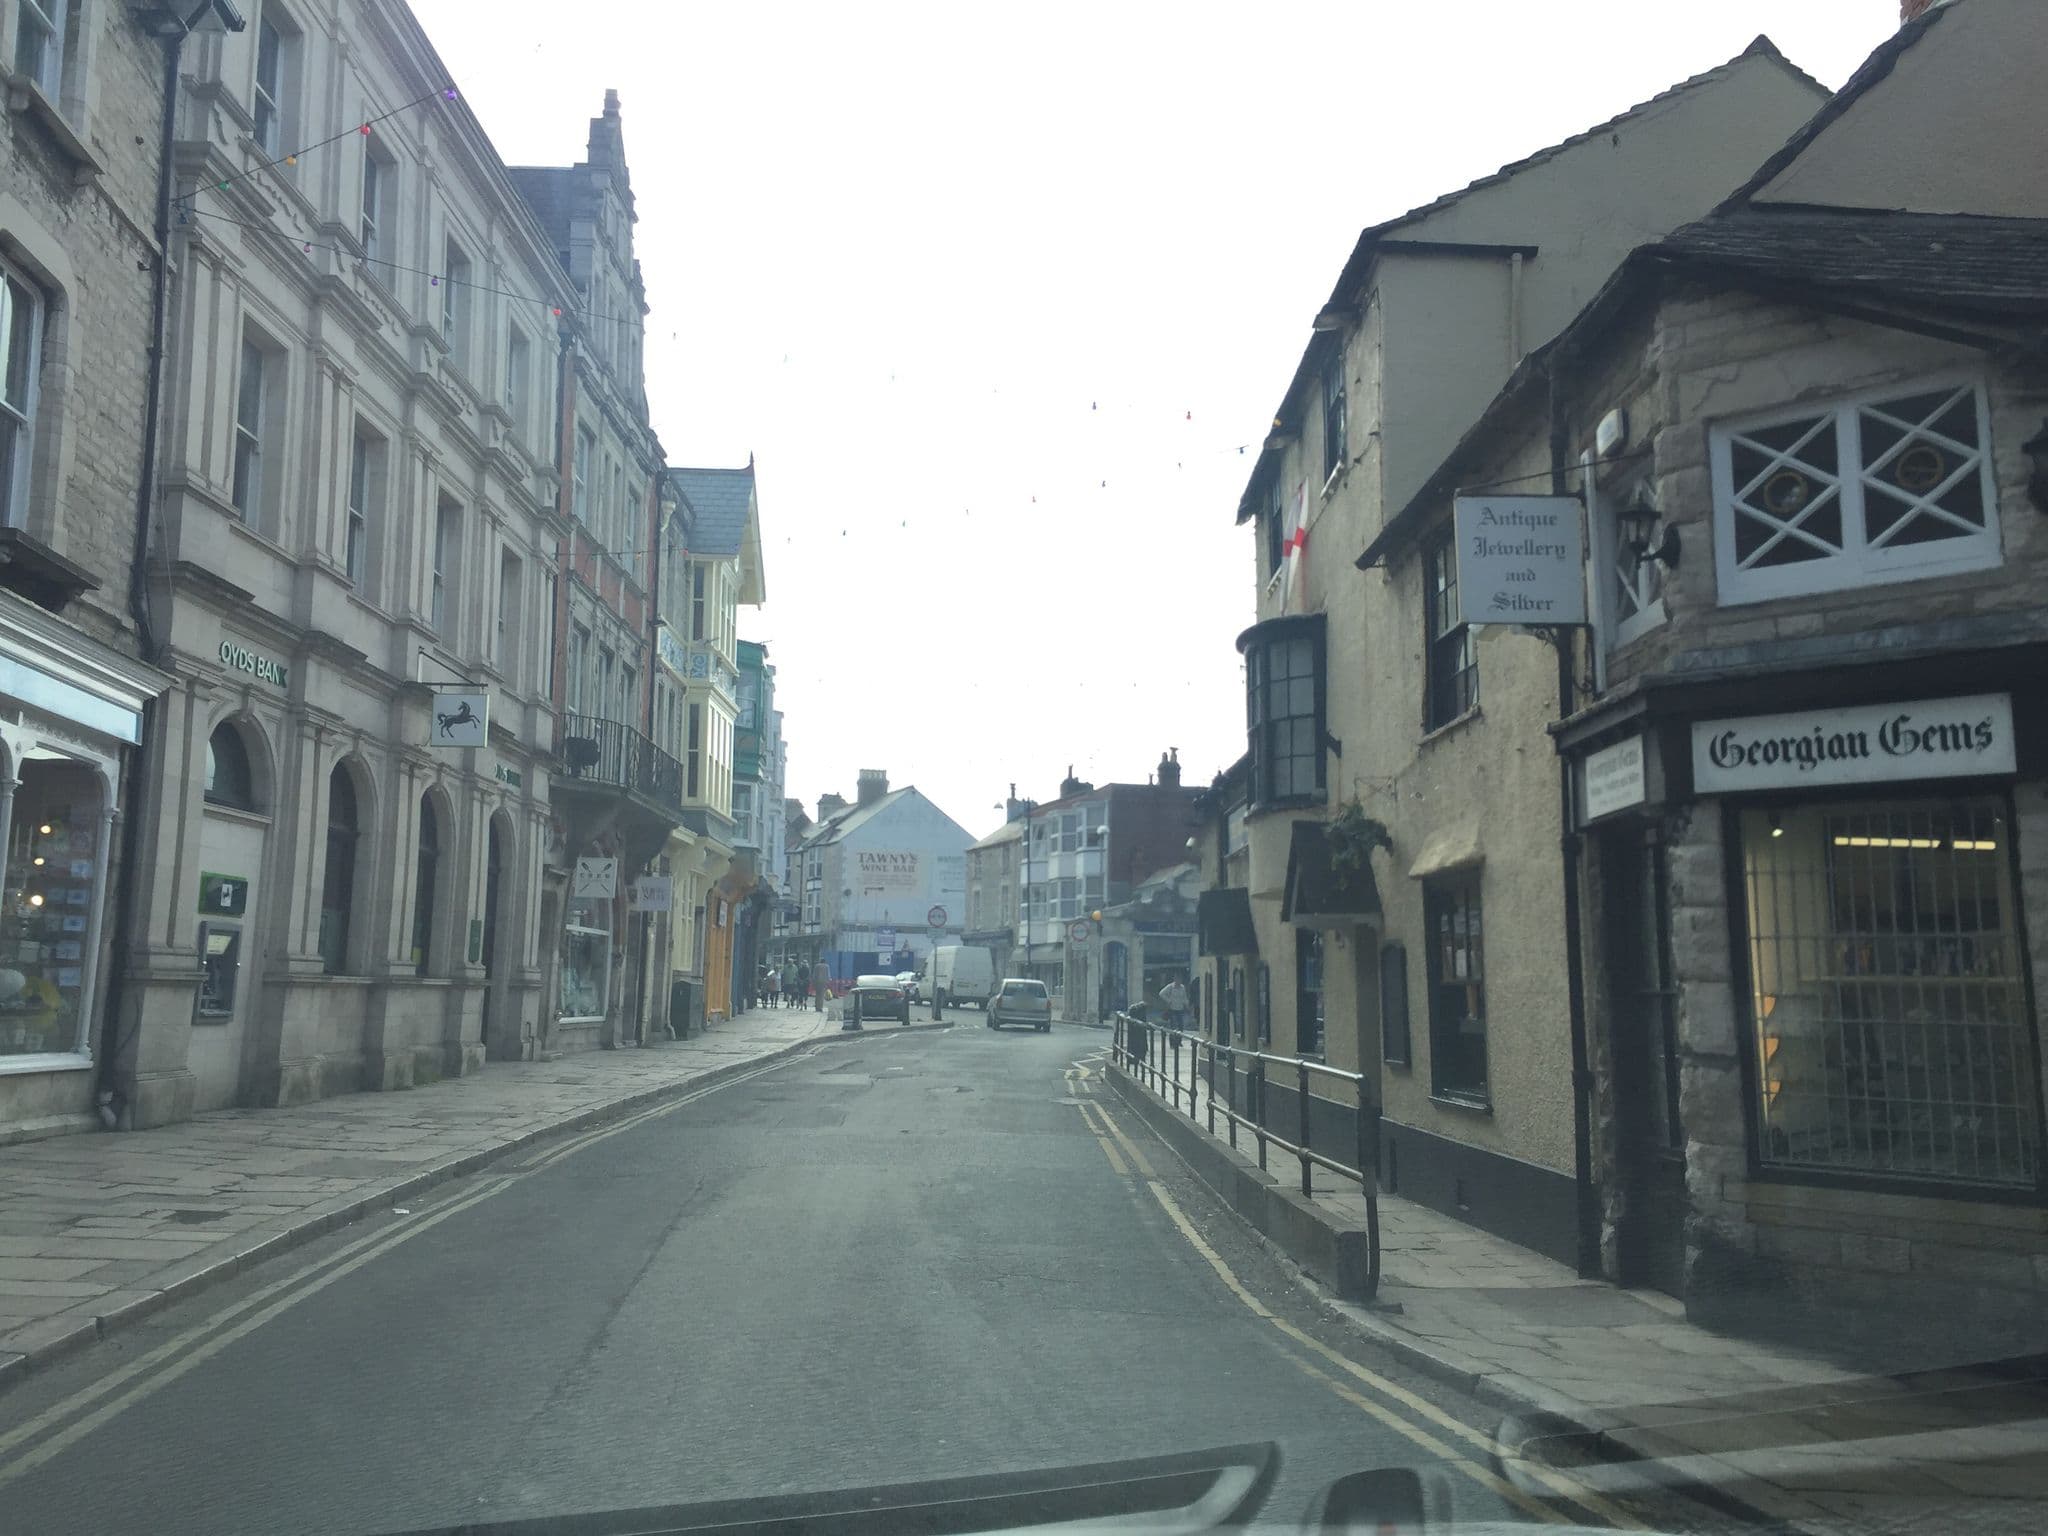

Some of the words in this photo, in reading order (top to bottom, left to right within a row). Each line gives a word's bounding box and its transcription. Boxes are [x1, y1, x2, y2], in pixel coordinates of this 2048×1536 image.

[1477, 506, 1558, 531] Antique
[1473, 536, 1567, 559] Jewellery
[1505, 568, 1536, 582] and
[1489, 592, 1554, 611] Silver
[256, 655, 288, 688] BANK
[1709, 726, 1870, 771] Georgian
[1879, 714, 1994, 756] Gems
[861, 864, 889, 873] WINE
[893, 864, 915, 873] BAR
